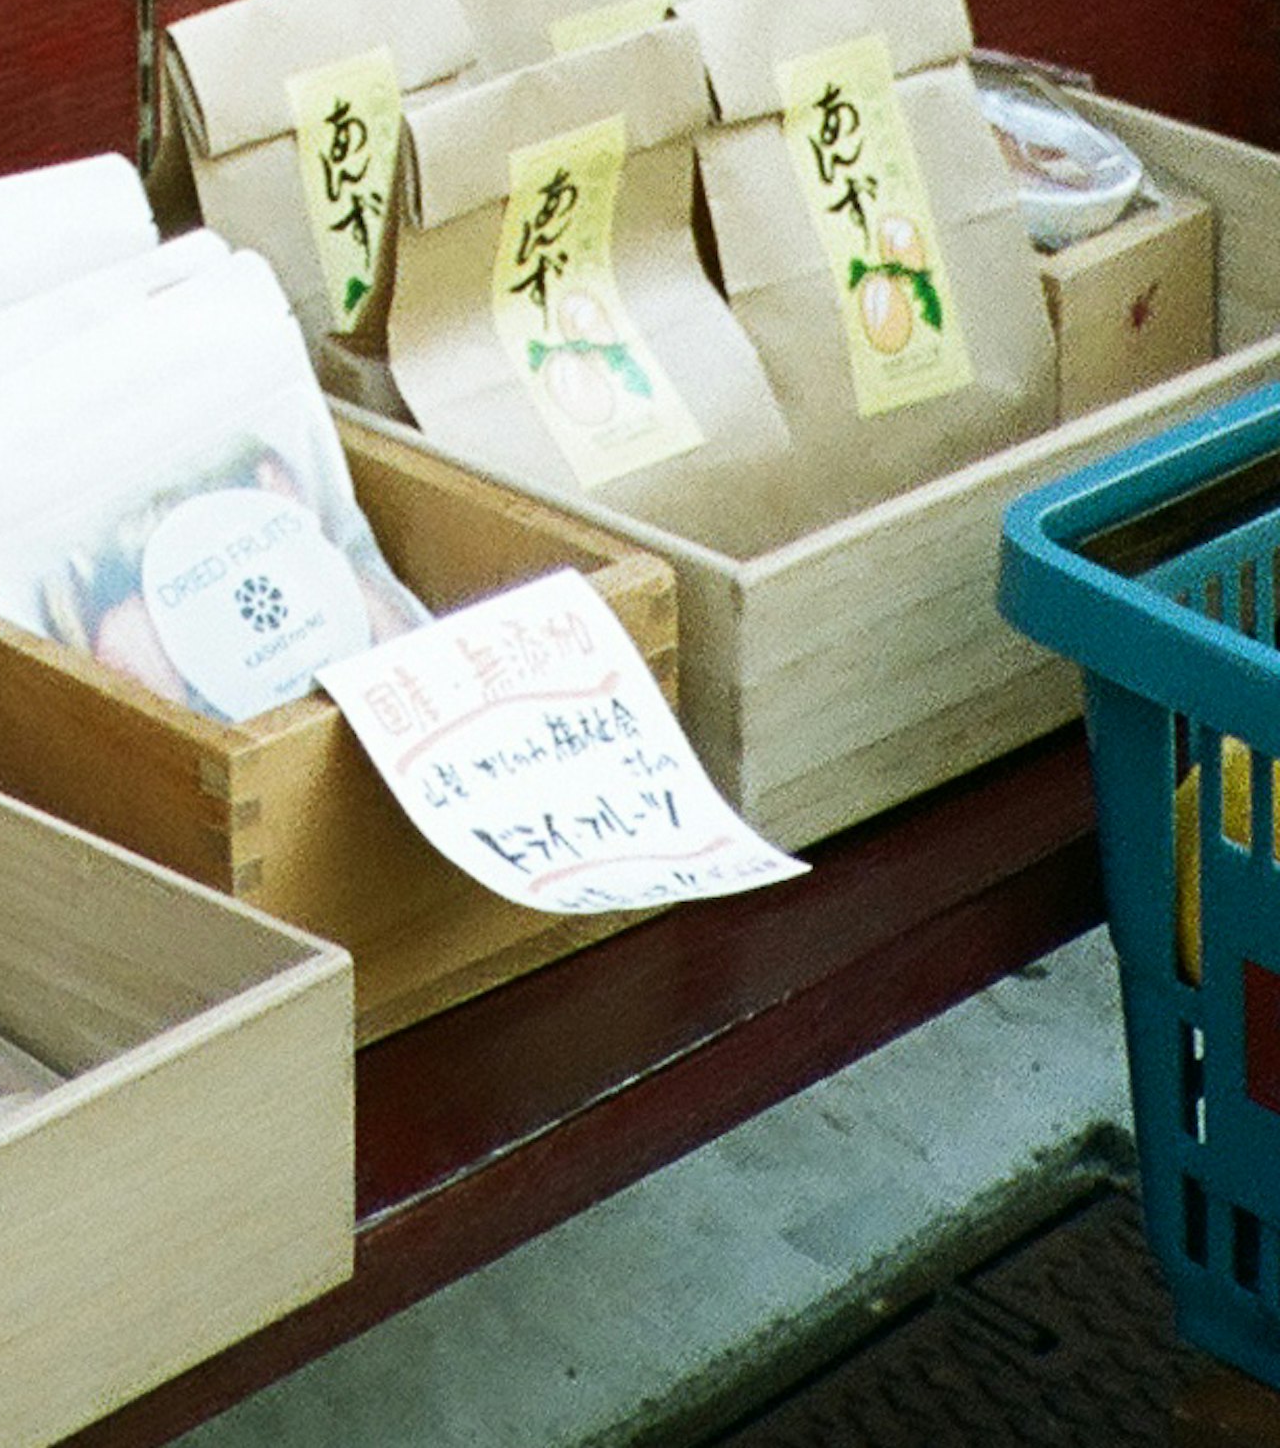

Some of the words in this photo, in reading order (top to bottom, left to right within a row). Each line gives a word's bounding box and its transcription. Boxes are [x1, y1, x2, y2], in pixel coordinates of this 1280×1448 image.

[320, 95, 383, 270] あんず
[509, 166, 579, 332] あんず
[808, 82, 879, 253] あんず
[158, 557, 228, 608] DRIED
